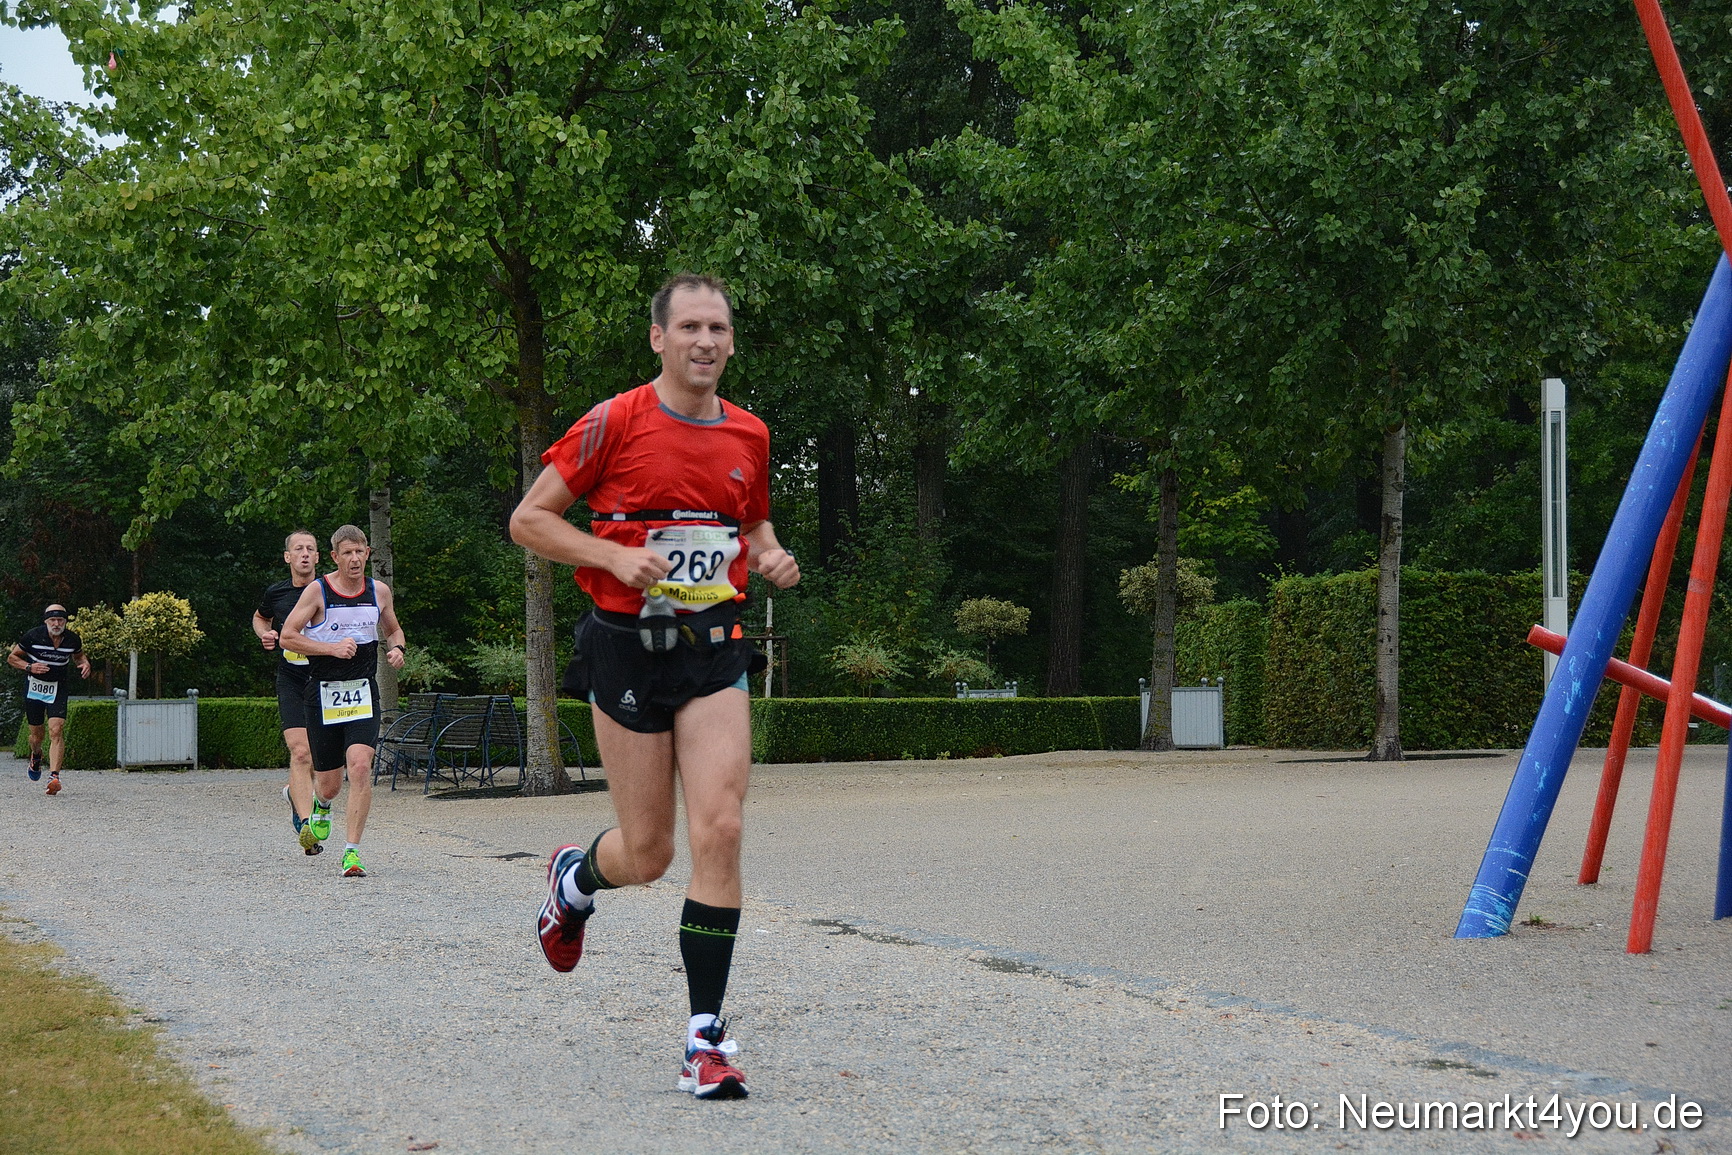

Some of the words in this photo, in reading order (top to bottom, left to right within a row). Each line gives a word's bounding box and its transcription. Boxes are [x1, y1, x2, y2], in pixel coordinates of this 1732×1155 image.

[672, 509, 712, 520] Continental
[32, 682, 55, 694] 3080
[331, 690, 363, 707] 244
[336, 709, 358, 717] Jürgen
[686, 922, 730, 933] FALKE
